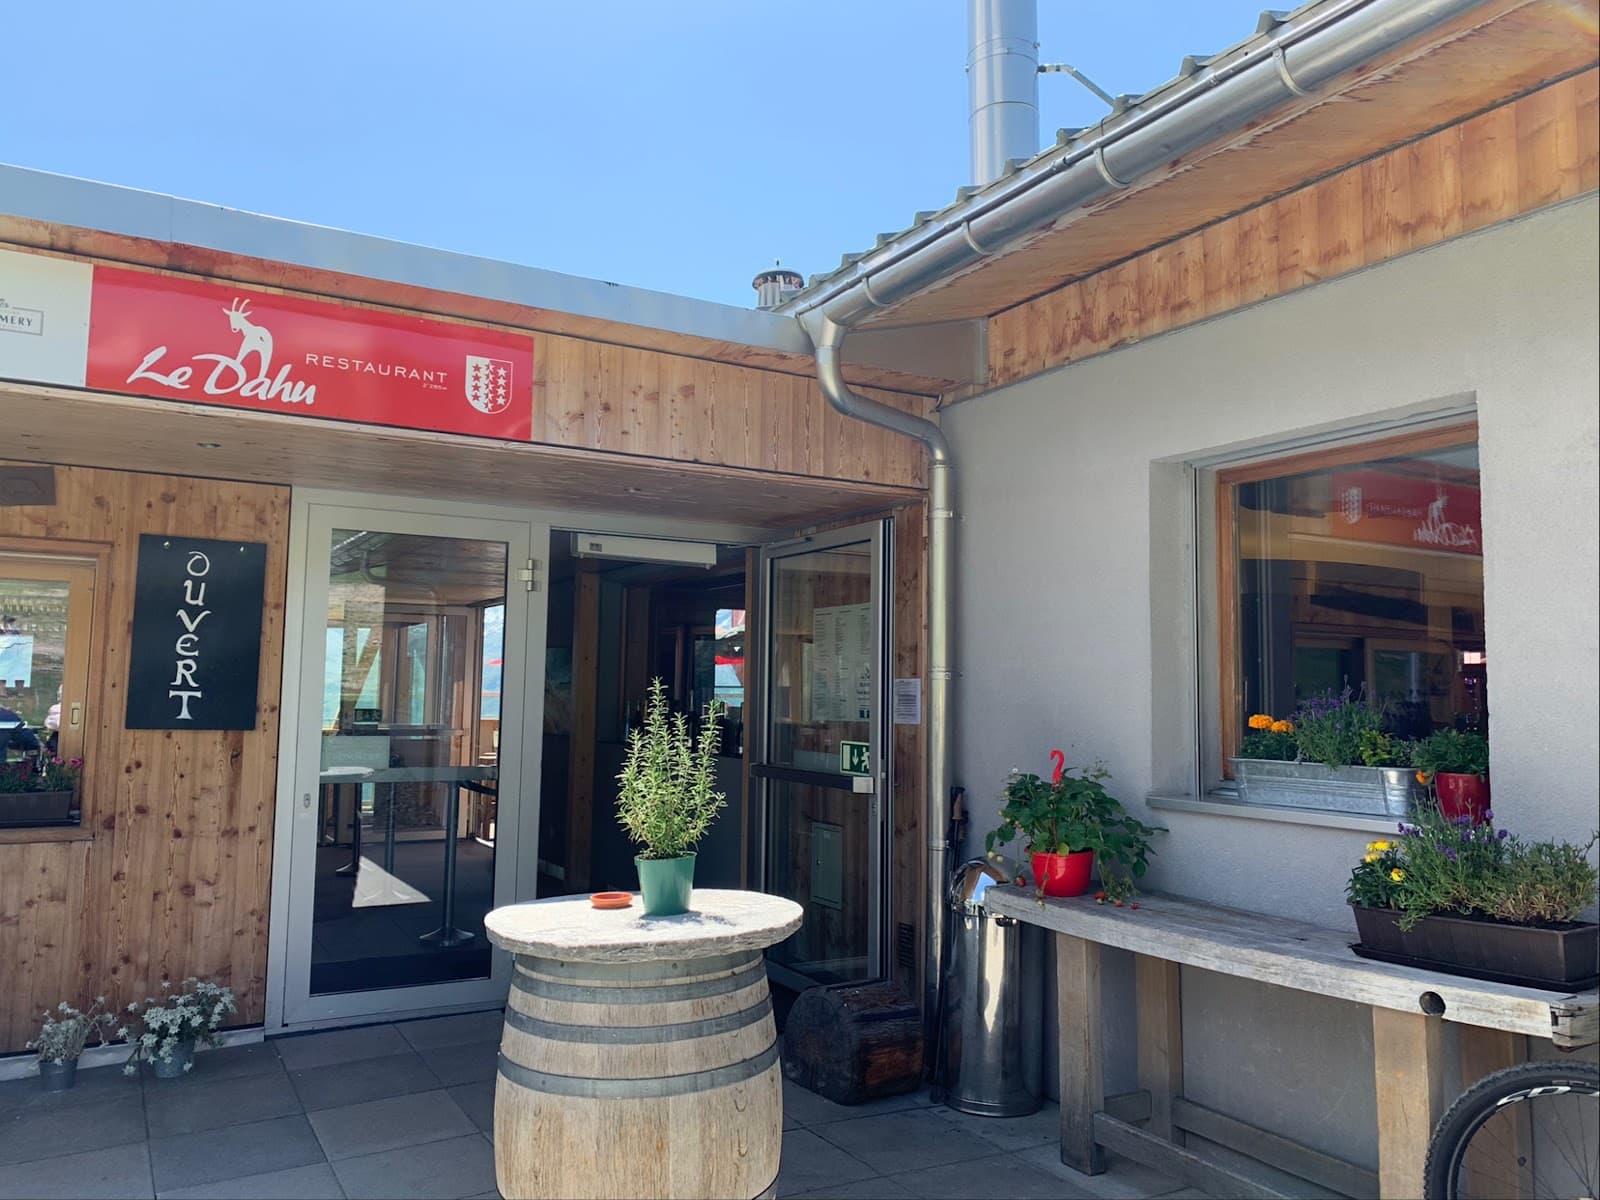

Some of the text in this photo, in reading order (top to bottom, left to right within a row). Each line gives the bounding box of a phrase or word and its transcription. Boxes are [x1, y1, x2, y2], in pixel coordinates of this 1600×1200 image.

[126, 345, 317, 405] Le Dahu
[305, 352, 448, 384] RESTAURANT
[168, 550, 212, 720] OUVERT
